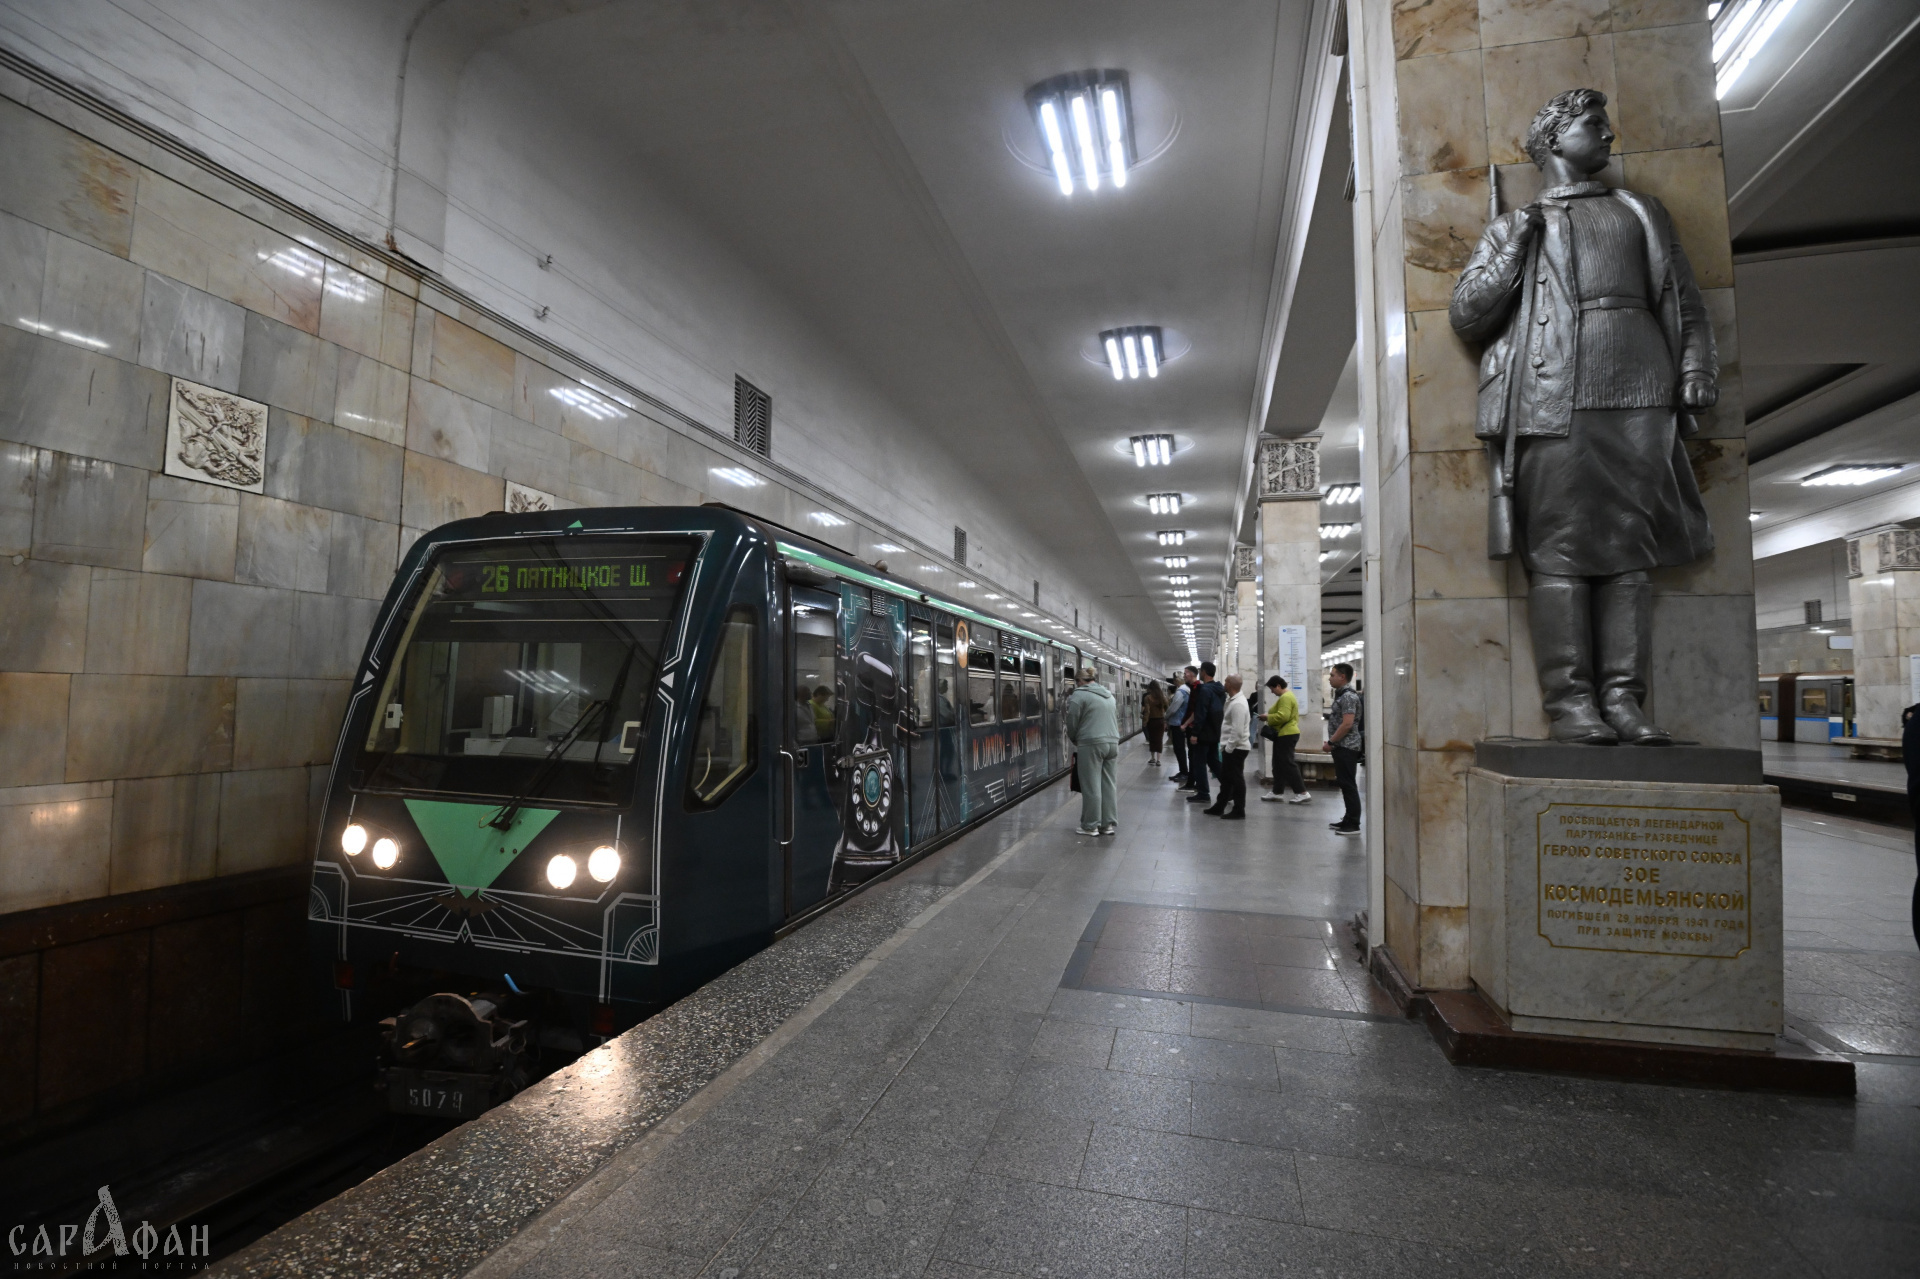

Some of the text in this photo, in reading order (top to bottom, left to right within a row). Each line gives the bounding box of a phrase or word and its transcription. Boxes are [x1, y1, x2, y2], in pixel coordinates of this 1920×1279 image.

[481, 564, 650, 593] 26 ПЯТНИЦКОЕ Ш.
[1559, 815, 1724, 831] ПОСВЯЩАЕТСЯ ЛЕГЕНДАРНОЙ
[1543, 844, 1742, 865] ГЕРОЮ СОВЕТСКОГО СОЮЗА
[1623, 866, 1660, 884] ЗОЕ
[1544, 883, 1745, 911] КОСМОДЕМЬЯНСКОЙ
[1547, 909, 1745, 931] ПОГИБШЕЙ 29 НОЯБРЯ 1941 ГОДА
[1577, 925, 1713, 943] ПРИ ЗАЩИТЕ МОСКВЫ
